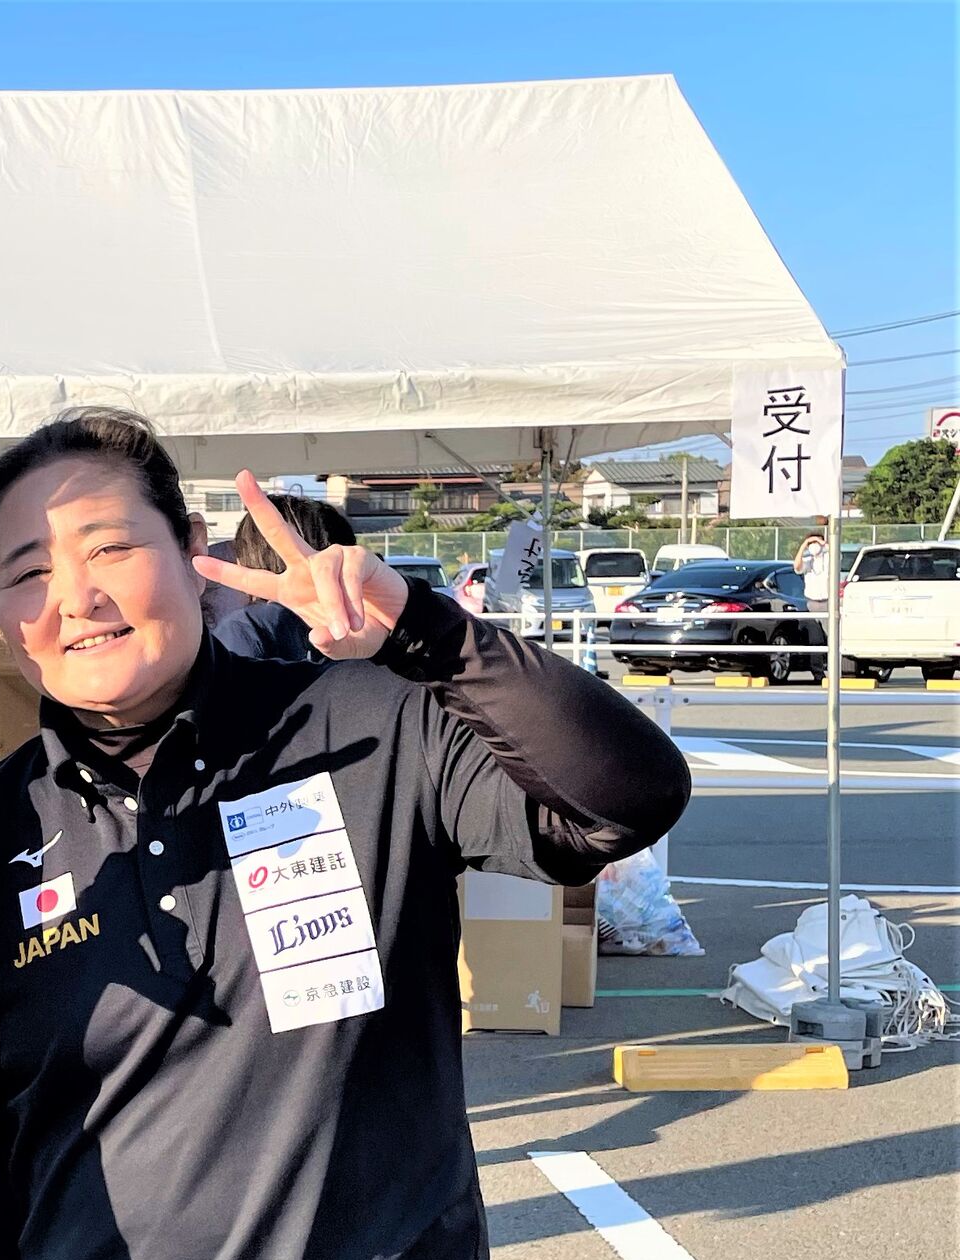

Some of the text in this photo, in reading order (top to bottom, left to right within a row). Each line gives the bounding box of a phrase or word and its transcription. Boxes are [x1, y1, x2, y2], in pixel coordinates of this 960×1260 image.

[761, 386, 811, 494] 受付
[271, 851, 347, 885] 大東建託
[13, 913, 101, 969] JAPAN
[268, 906, 354, 956] Lions
[305, 975, 371, 1002] 京急建設
